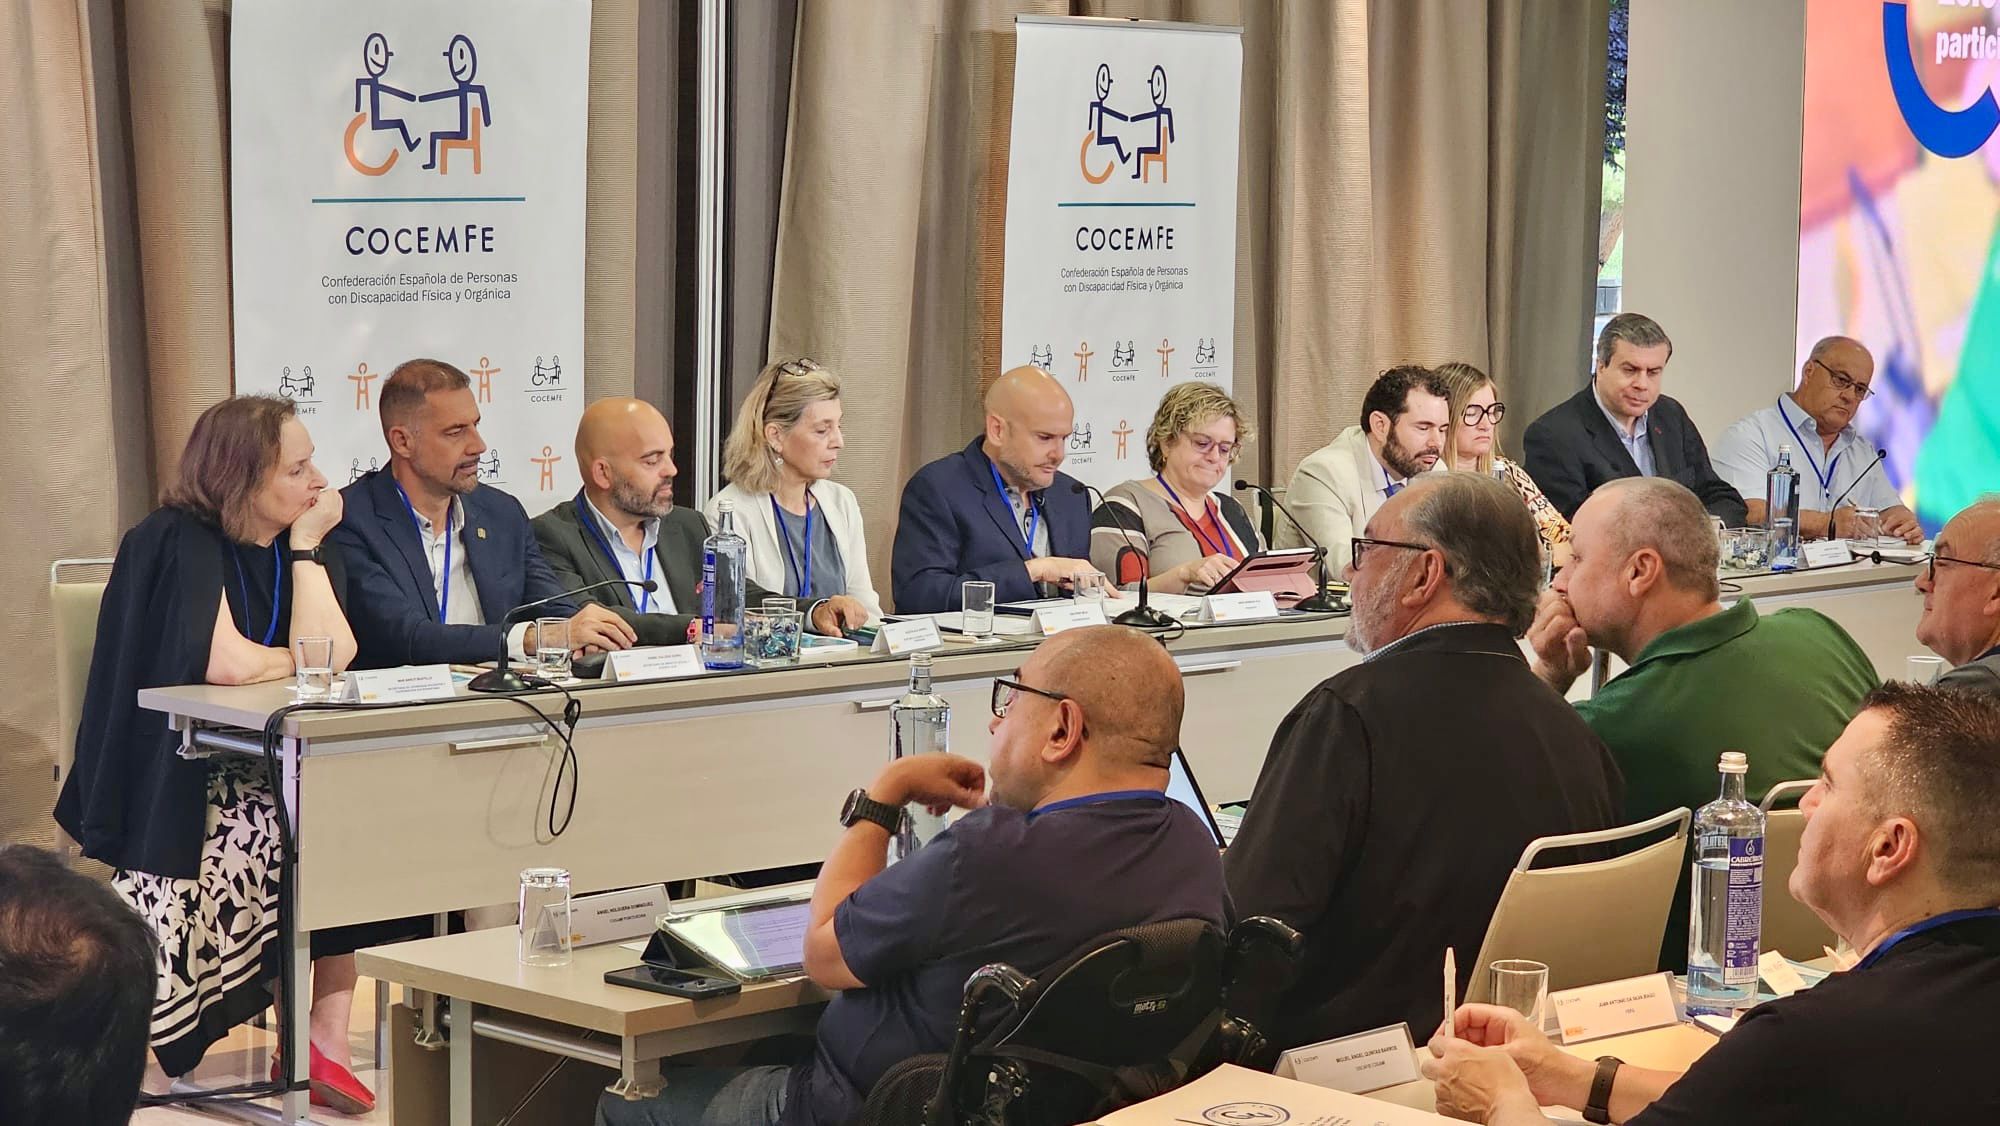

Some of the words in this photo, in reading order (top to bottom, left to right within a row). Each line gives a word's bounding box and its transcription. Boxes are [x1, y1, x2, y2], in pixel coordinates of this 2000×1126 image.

[345, 224, 494, 255] COCEMFE
[1076, 225, 1174, 251] COCEMFE
[321, 274, 396, 288] Confederación
[399, 272, 447, 287] Española
[450, 272, 463, 284] de
[467, 271, 518, 284] Personas
[1061, 267, 1109, 279] Confederación
[1111, 266, 1144, 279] Española
[1146, 267, 1155, 277] de
[1157, 266, 1188, 276] Personas
[1064, 284, 1077, 292] con
[1079, 281, 1125, 293] Discapacidad
[1126, 280, 1147, 291] Física
[1155, 279, 1184, 292] Orgánica
[328, 294, 347, 304] con
[350, 289, 419, 304] Discapacidad
[422, 288, 452, 302] Física
[455, 290, 461, 303] y
[464, 287, 511, 303] Orgánica
[297, 407, 316, 415] EMFE
